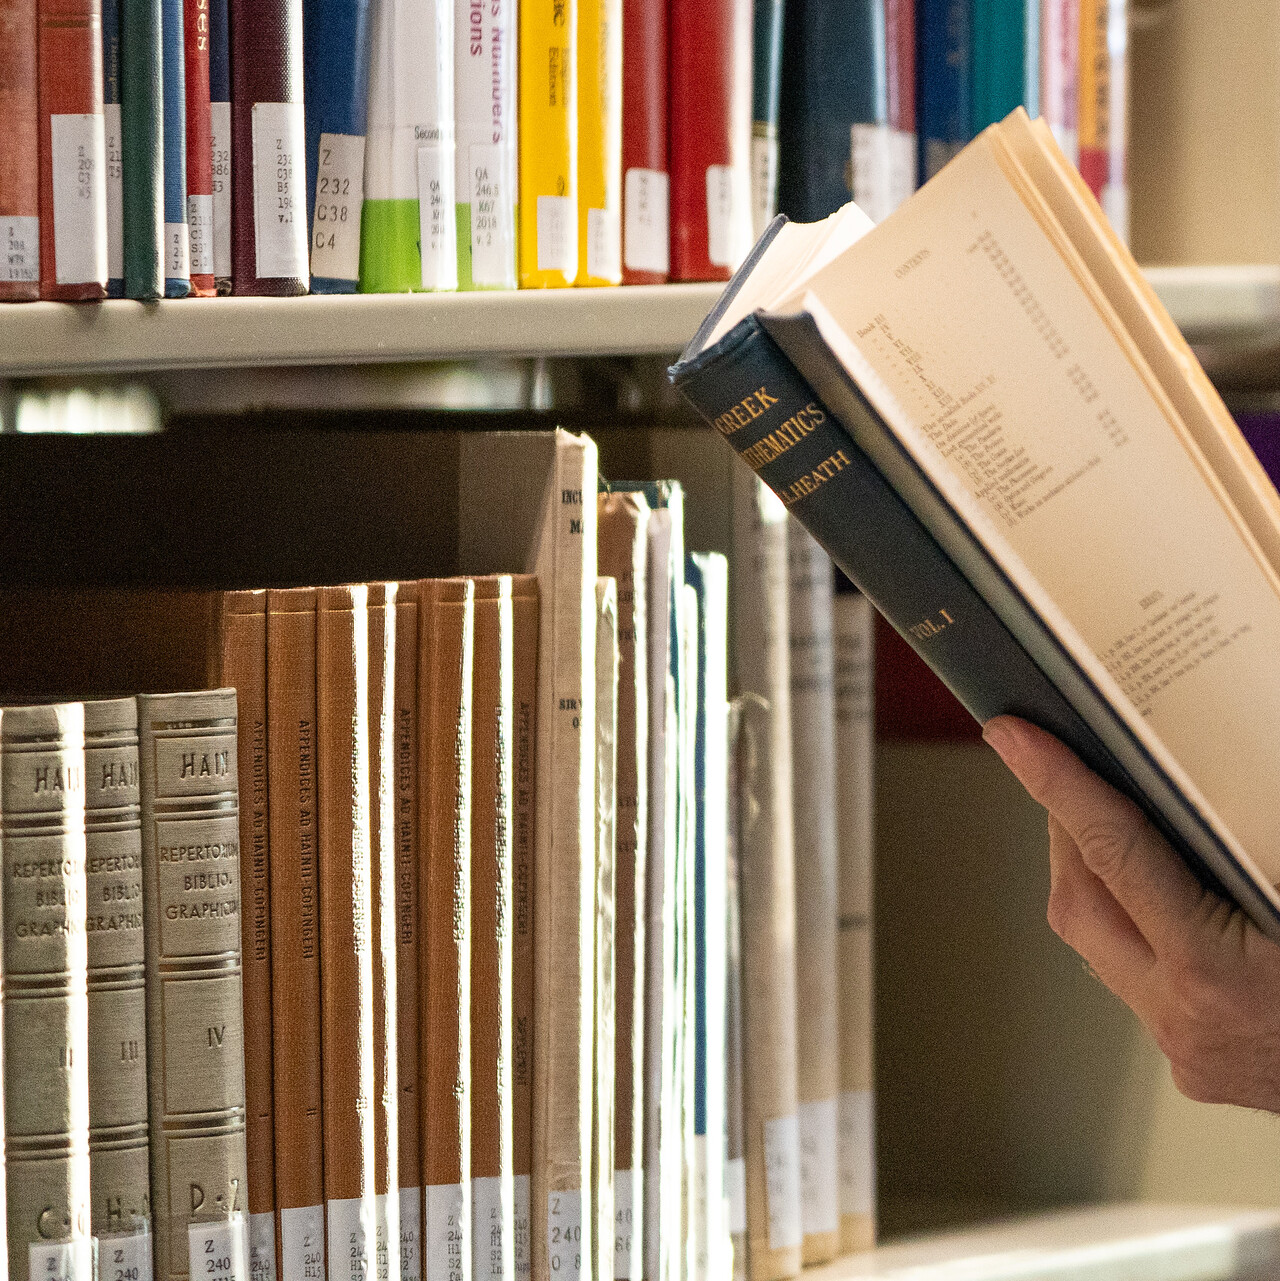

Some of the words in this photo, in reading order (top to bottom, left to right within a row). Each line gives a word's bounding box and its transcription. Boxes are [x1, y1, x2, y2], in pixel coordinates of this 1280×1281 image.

[276, 139, 282, 150] Z
[322, 149, 332, 166] Z
[475, 167, 488, 181] QA
[277, 181, 289, 193] B5
[320, 178, 350, 195] 232
[318, 205, 348, 222] C38
[315, 232, 336, 249] C4
[856, 320, 876, 338] Book
[714, 386, 779, 435] GREEK
[742, 401, 826, 471] THEMATICS
[910, 615, 946, 641] VOL.
[559, 699, 577, 710] SIR
[401, 708, 412, 792] APPENDICES
[180, 750, 230, 779] HAIN
[253, 721, 265, 805] APPENDICES
[300, 719, 312, 807] APPENDICES
[401, 798, 412, 815] AD
[253, 812, 264, 830] AD
[301, 811, 311, 830] AD
[184, 873, 232, 891] BIBLIO.
[208, 1026, 225, 1048] IV
[120, 1040, 139, 1063] III
[491, 1208, 497, 1218] Z
[552, 1198, 560, 1215] Z
[448, 1216, 454, 1226] Z
[350, 1232, 356, 1243] Z
[376, 1226, 382, 1236] Z
[552, 1227, 581, 1243] 240
[205, 1239, 214, 1253] Z
[304, 1236, 310, 1247] Z
[114, 1249, 123, 1263] Z
[304, 1252, 321, 1265] 240
[449, 1258, 461, 1269] S2
[491, 1250, 502, 1261] S2
[206, 1257, 231, 1273] 240
[251, 1259, 270, 1272] 240
[304, 1266, 321, 1278] H15
[376, 1268, 388, 1279] S2
